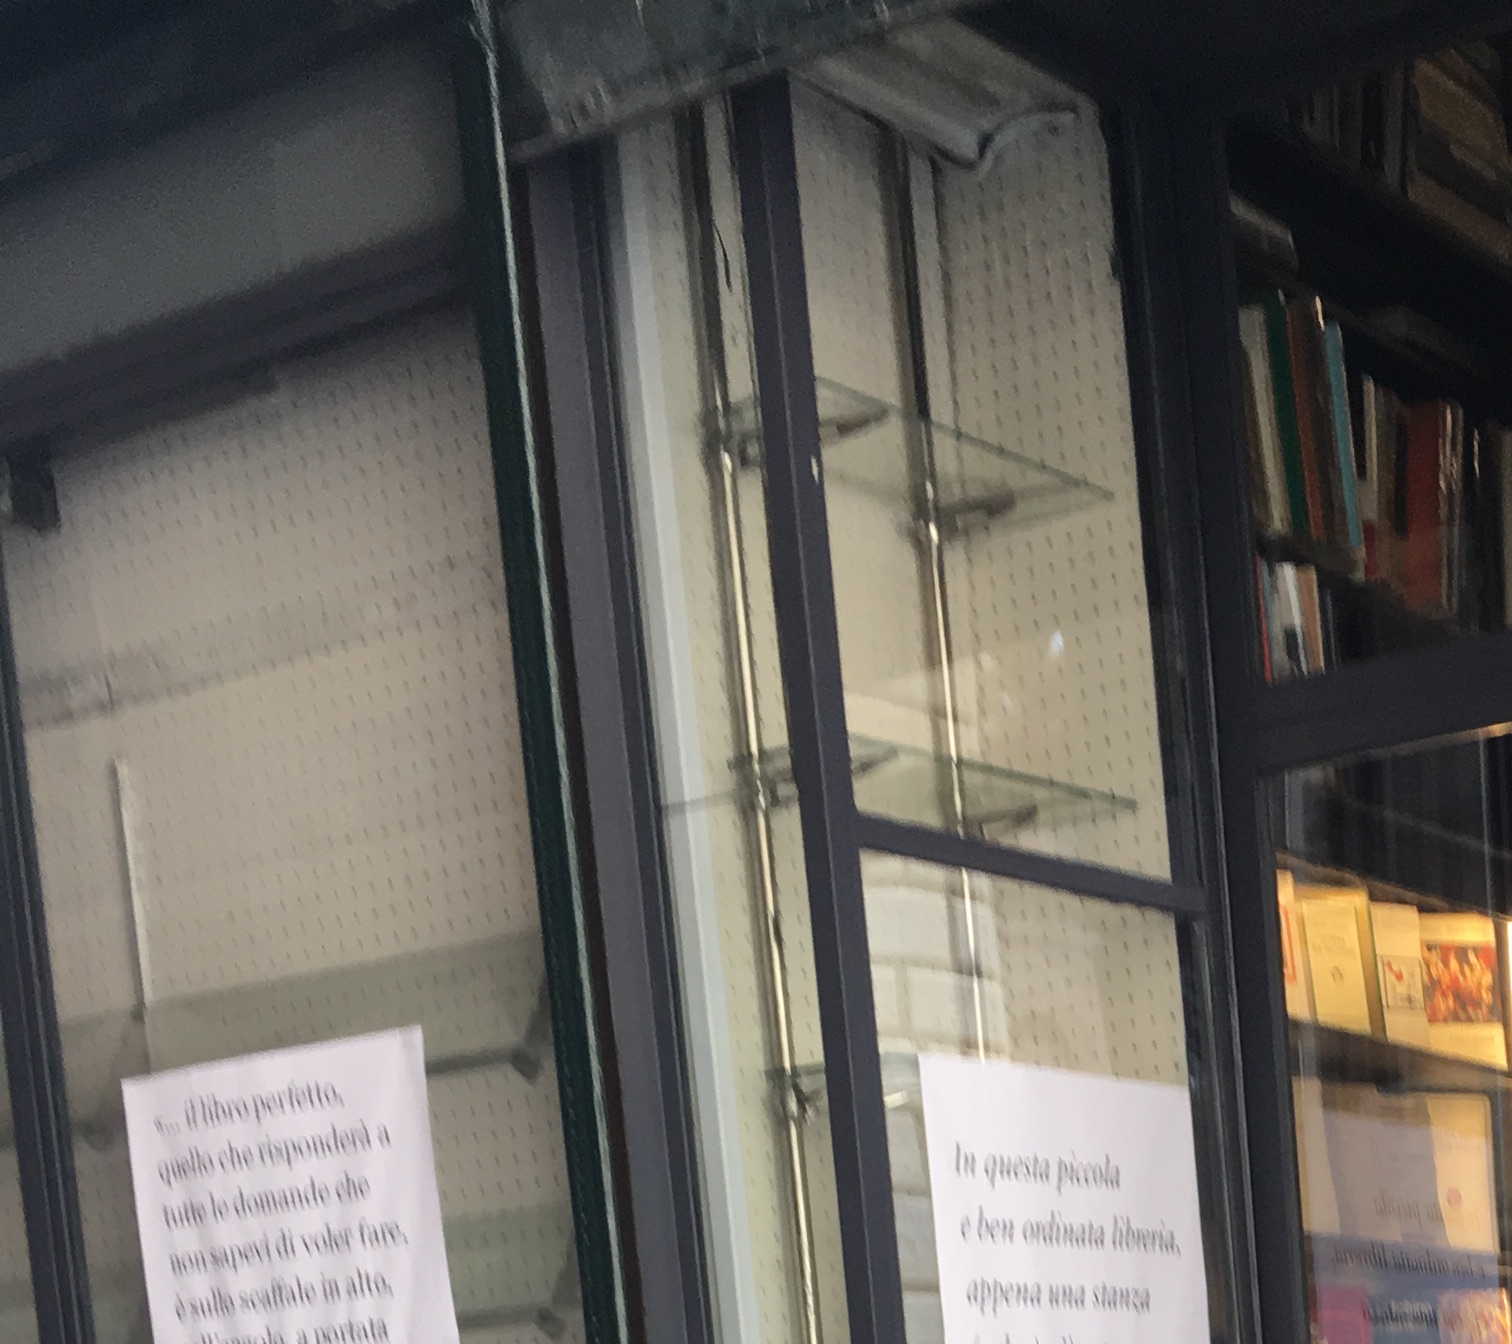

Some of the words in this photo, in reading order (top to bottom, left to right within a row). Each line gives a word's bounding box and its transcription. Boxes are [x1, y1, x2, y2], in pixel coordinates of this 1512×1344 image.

[157, 1145, 215, 1191] quello
[219, 1139, 253, 1175] che
[258, 1118, 372, 1171] risponderà
[377, 1123, 392, 1149] a
[955, 1140, 977, 1179] In
[983, 1152, 1051, 1191] questa
[1056, 1149, 1121, 1196] piccola
[163, 1197, 207, 1231] tutte
[209, 1189, 229, 1223] le
[234, 1175, 331, 1219] domande
[335, 1169, 371, 1204] che
[960, 1214, 971, 1242] e
[977, 1203, 1015, 1245] ben
[1022, 1208, 1105, 1251] ordinata
[966, 1276, 1042, 1318] appena
[1048, 1283, 1086, 1310] una
[1092, 1281, 1151, 1316] stanza
